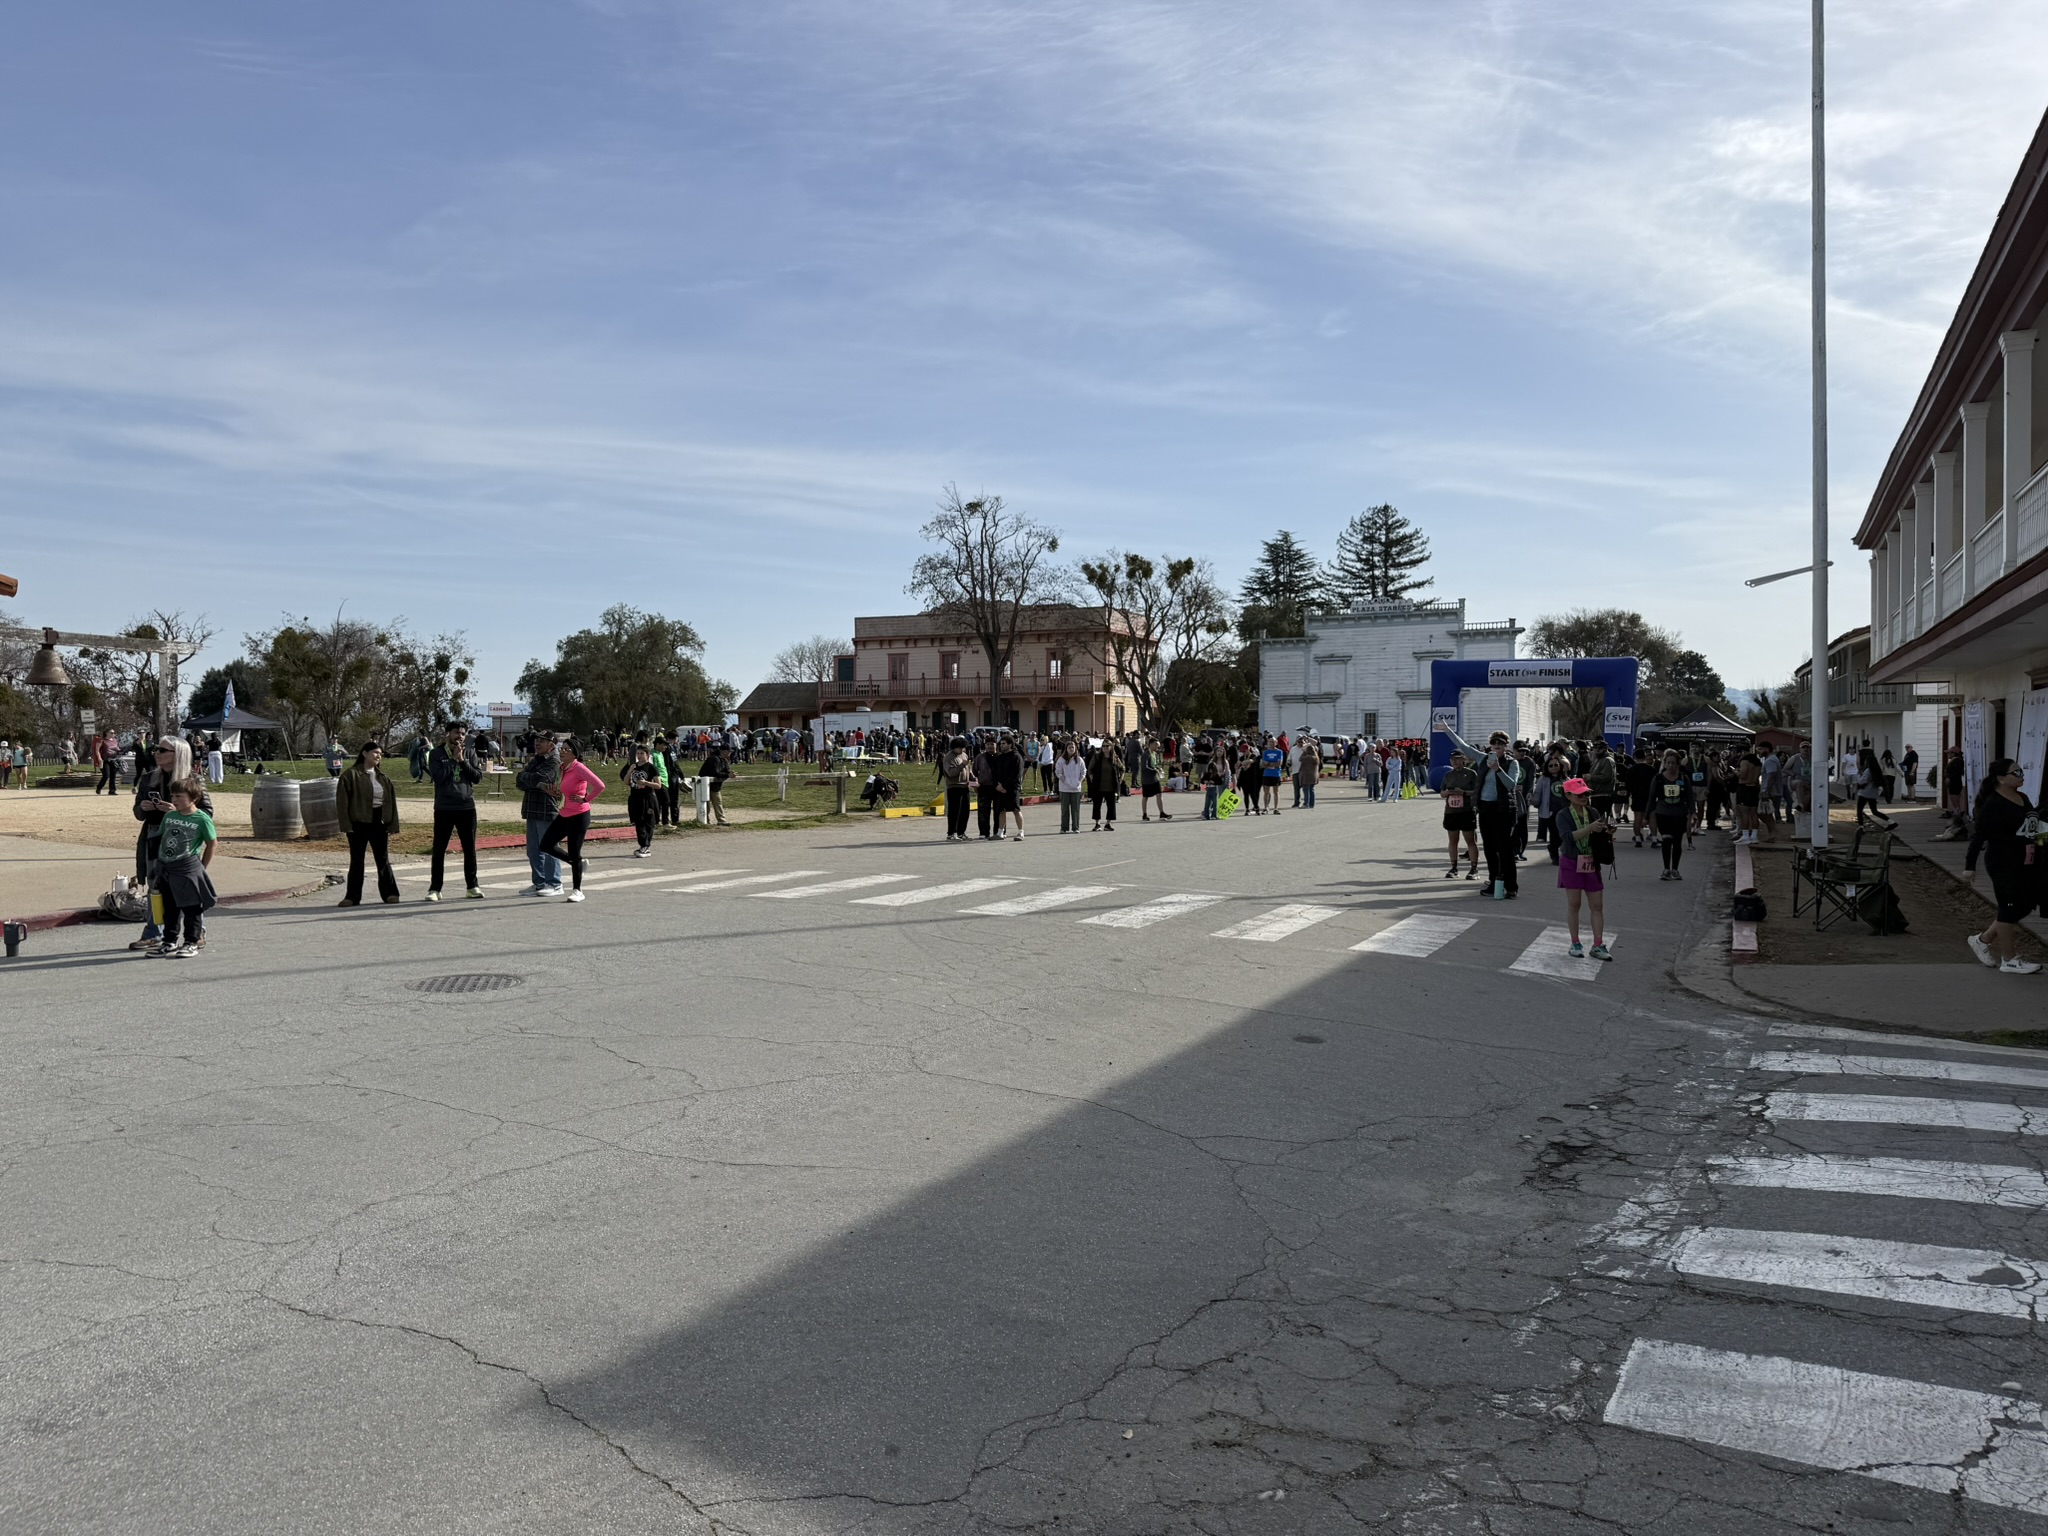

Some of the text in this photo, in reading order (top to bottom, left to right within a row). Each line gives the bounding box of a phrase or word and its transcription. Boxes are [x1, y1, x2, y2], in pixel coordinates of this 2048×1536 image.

[1379, 604, 1412, 612] STABLES
[1489, 669, 1520, 677] START
[1539, 668, 1571, 676] FINISH
[1916, 695, 1952, 703] Entrance
[165, 818, 199, 829] EVOLVE
